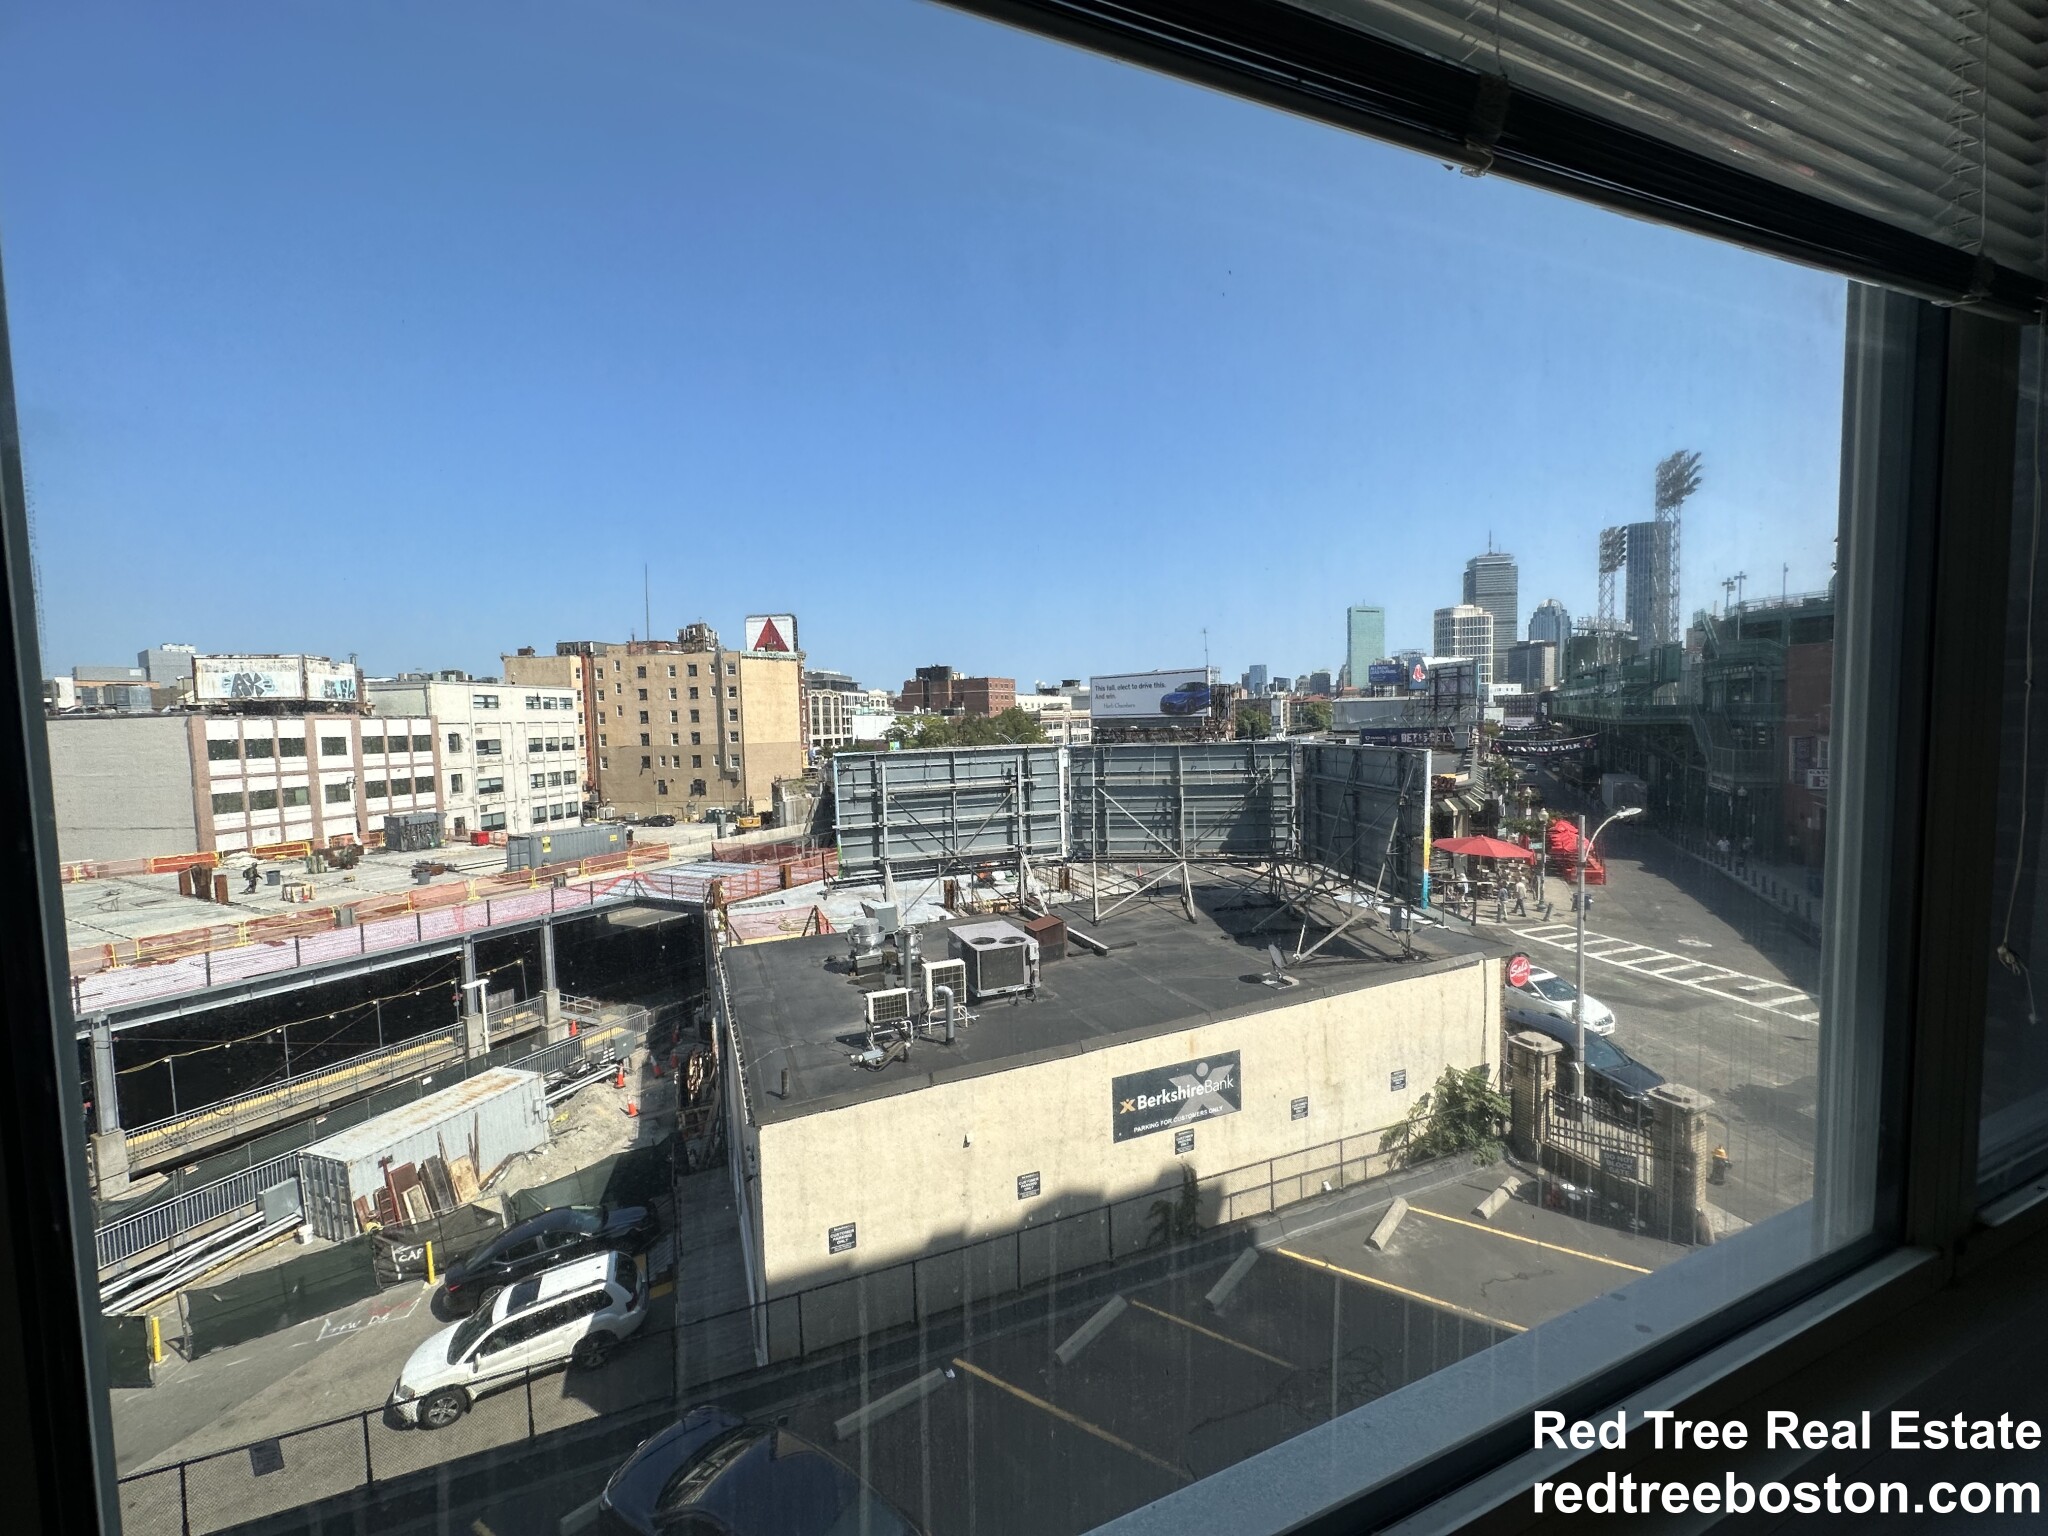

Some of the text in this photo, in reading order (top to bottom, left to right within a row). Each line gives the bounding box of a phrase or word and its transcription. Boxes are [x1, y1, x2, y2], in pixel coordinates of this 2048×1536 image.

[1095, 684, 1106, 692] This
[1117, 683, 1131, 691] elect
[1133, 1105, 1223, 1133] PARKING FOR CUSTOMERS ONLY
[1604, 1152, 1634, 1164] DO NOT
[1606, 1159, 1633, 1170] BLOCK
[1609, 1166, 1630, 1176] GATE
[830, 1228, 855, 1239] CUSTOMER
[832, 1233, 853, 1242] PARKING
